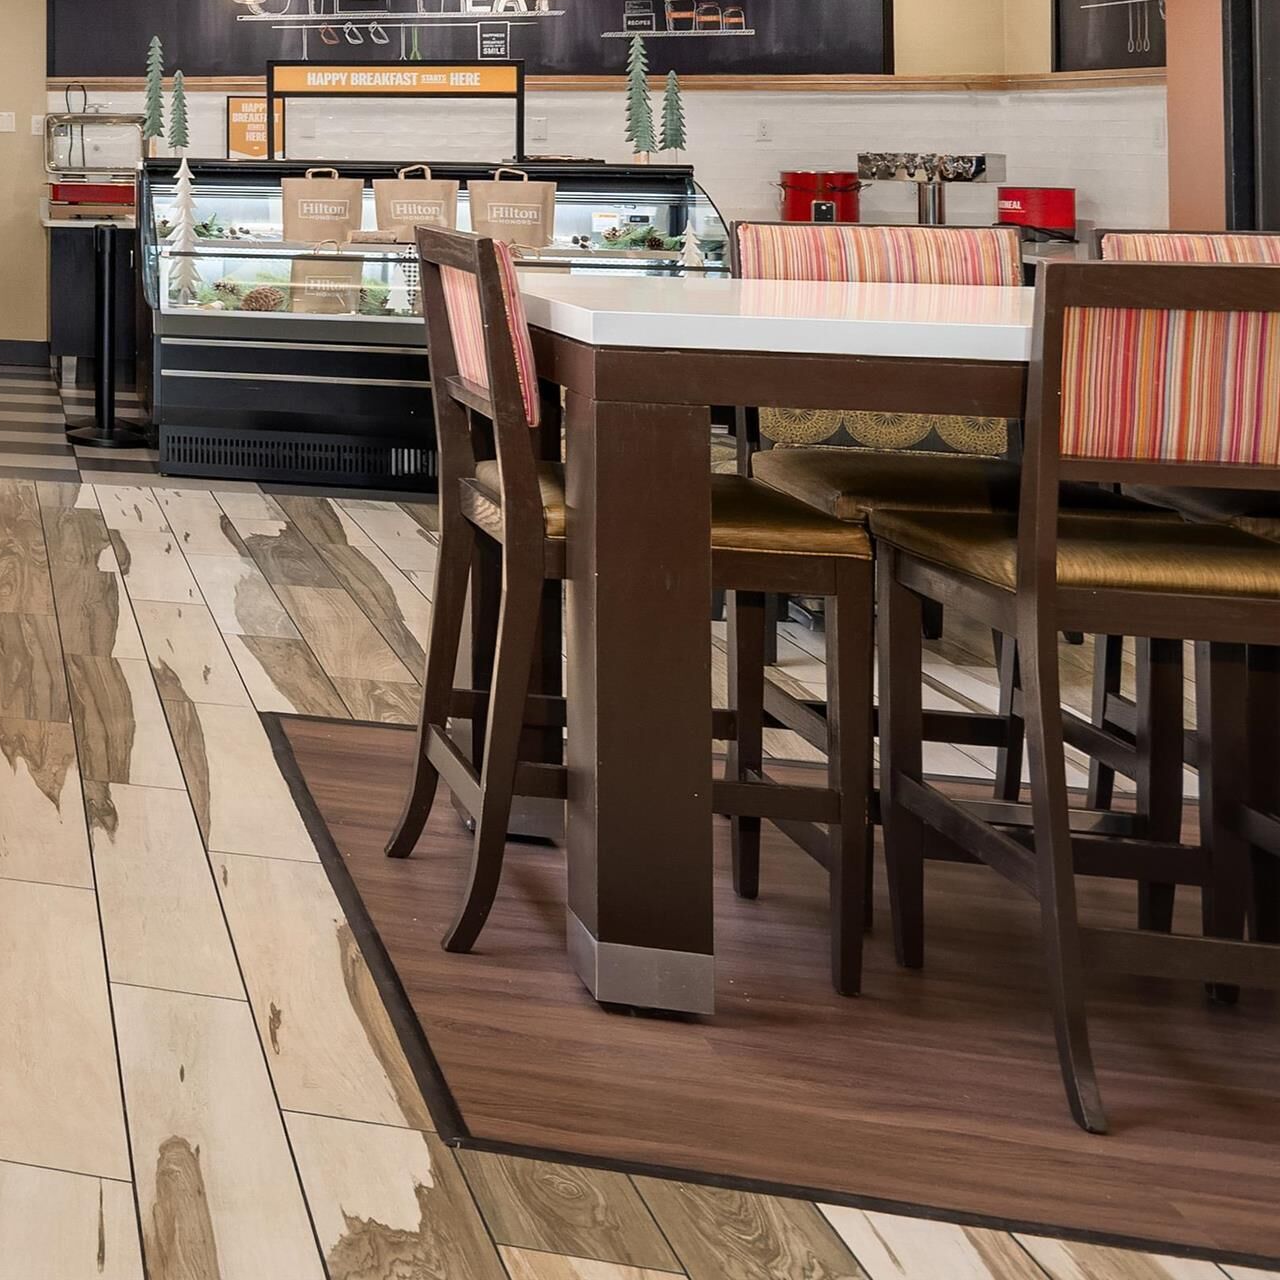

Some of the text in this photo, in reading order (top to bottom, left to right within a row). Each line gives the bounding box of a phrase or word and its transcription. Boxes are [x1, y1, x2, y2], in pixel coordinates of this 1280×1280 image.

[307, 72, 348, 86] HAPPY
[350, 72, 418, 86] BREAKFAST
[449, 72, 481, 86] HERE
[303, 202, 349, 215] Hilton
[395, 203, 441, 216] Hilton
[492, 205, 538, 219] Hilton
[307, 278, 351, 291] Hilton
